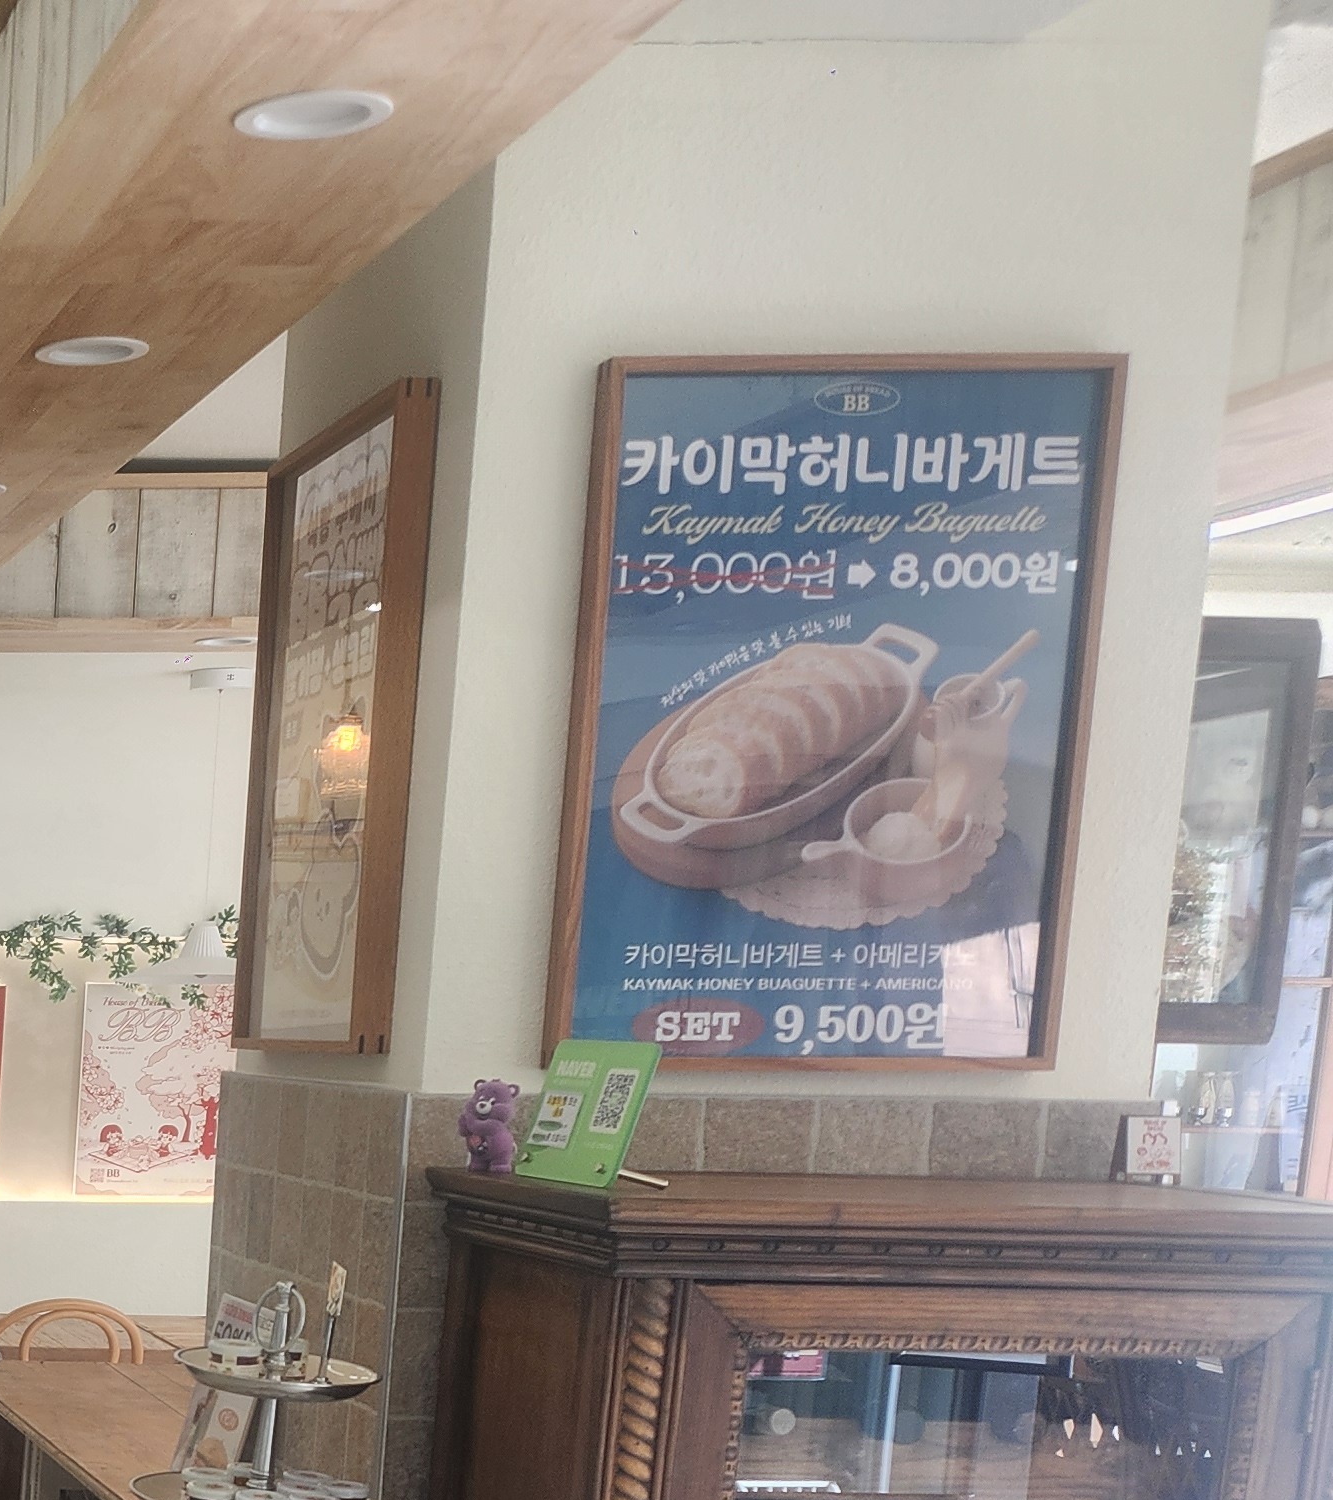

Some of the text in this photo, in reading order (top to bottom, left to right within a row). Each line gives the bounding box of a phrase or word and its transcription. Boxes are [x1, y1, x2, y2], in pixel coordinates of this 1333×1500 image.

[843, 394, 869, 411] BB
[622, 433, 1081, 494] 카이막허니바게트
[641, 501, 785, 545] Kaymak
[794, 503, 901, 545] Honey
[614, 550, 1058, 604] 13,000원 8,000원
[623, 942, 976, 968] 카이막허니바게트 아메리카노
[622, 977, 694, 991] KAYMAK
[697, 977, 754, 991] HONEY
[758, 977, 856, 992] BUAGUETTE
[98, 1006, 186, 1042] BB
[654, 1002, 946, 1055] SET 9,500원
[554, 1059, 598, 1079] NAVER
